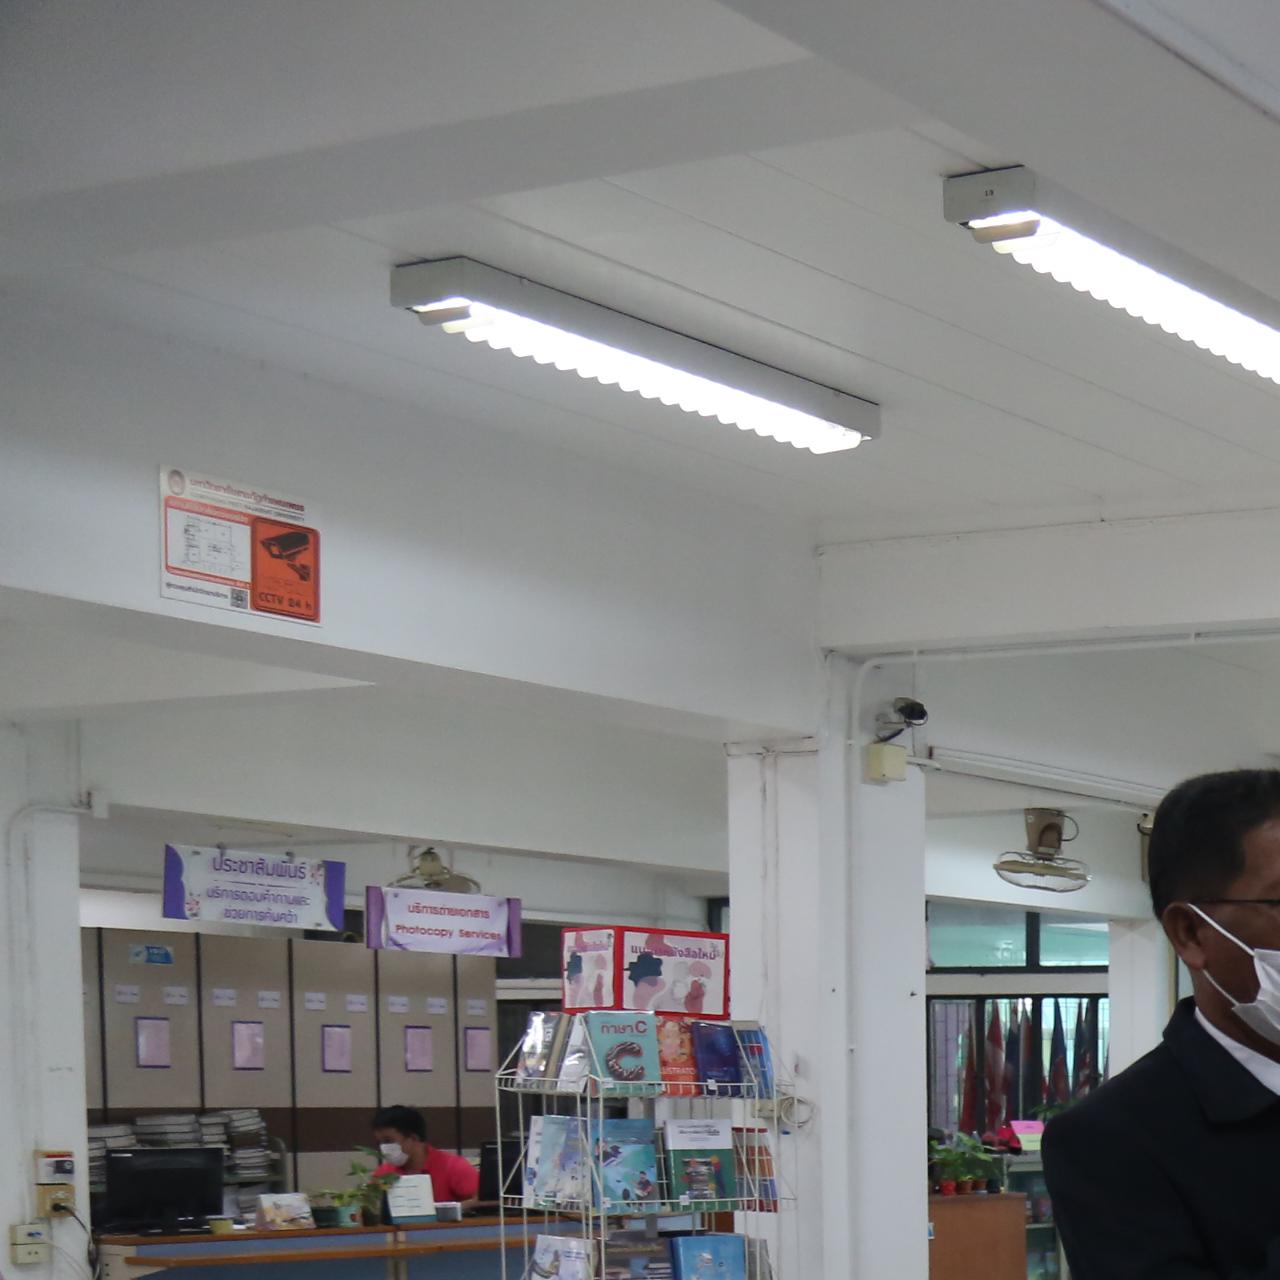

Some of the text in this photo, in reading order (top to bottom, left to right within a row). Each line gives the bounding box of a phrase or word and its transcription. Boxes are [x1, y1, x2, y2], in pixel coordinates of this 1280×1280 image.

[212, 856, 306, 880] ประชาสัมพันธ์
[395, 923, 454, 938] Photocopy
